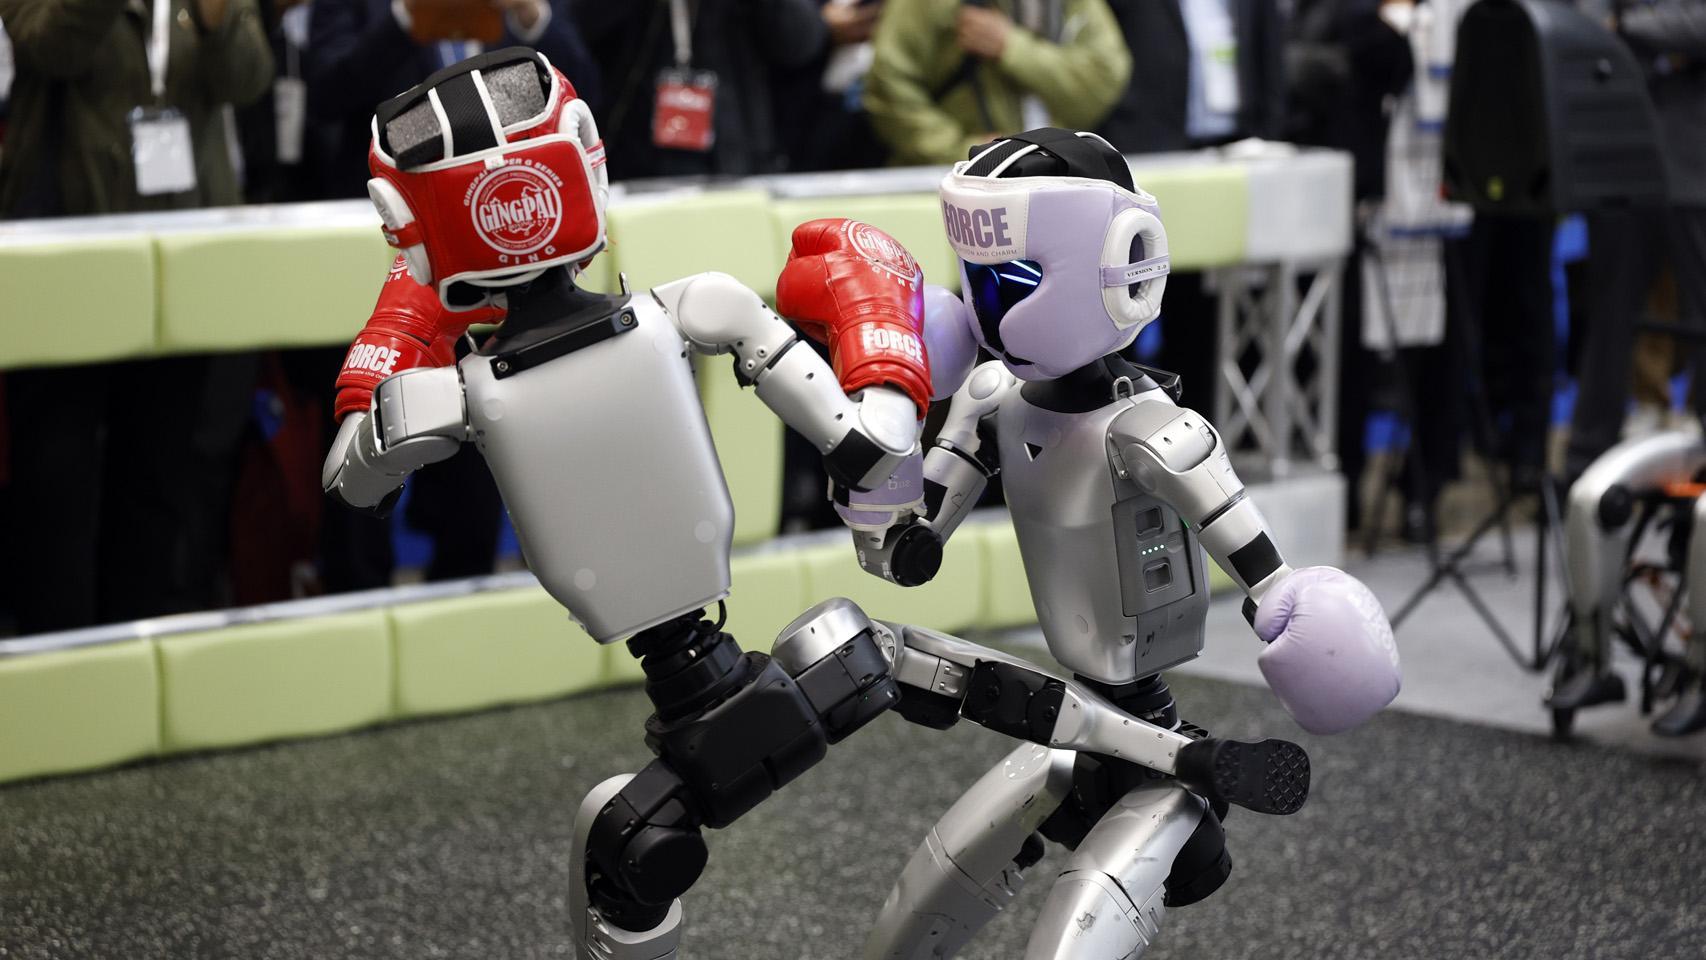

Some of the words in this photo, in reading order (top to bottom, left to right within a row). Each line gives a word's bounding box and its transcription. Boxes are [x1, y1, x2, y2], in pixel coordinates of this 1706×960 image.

[464, 170, 488, 206] GINGPAI
[534, 162, 563, 187] SERIES
[479, 188, 556, 232] GINGPAI
[944, 200, 1012, 248] FORCE
[498, 245, 556, 264] GING
[1127, 267, 1152, 278] VERSION
[344, 344, 401, 376] FORCE
[862, 328, 924, 364] FORCE
